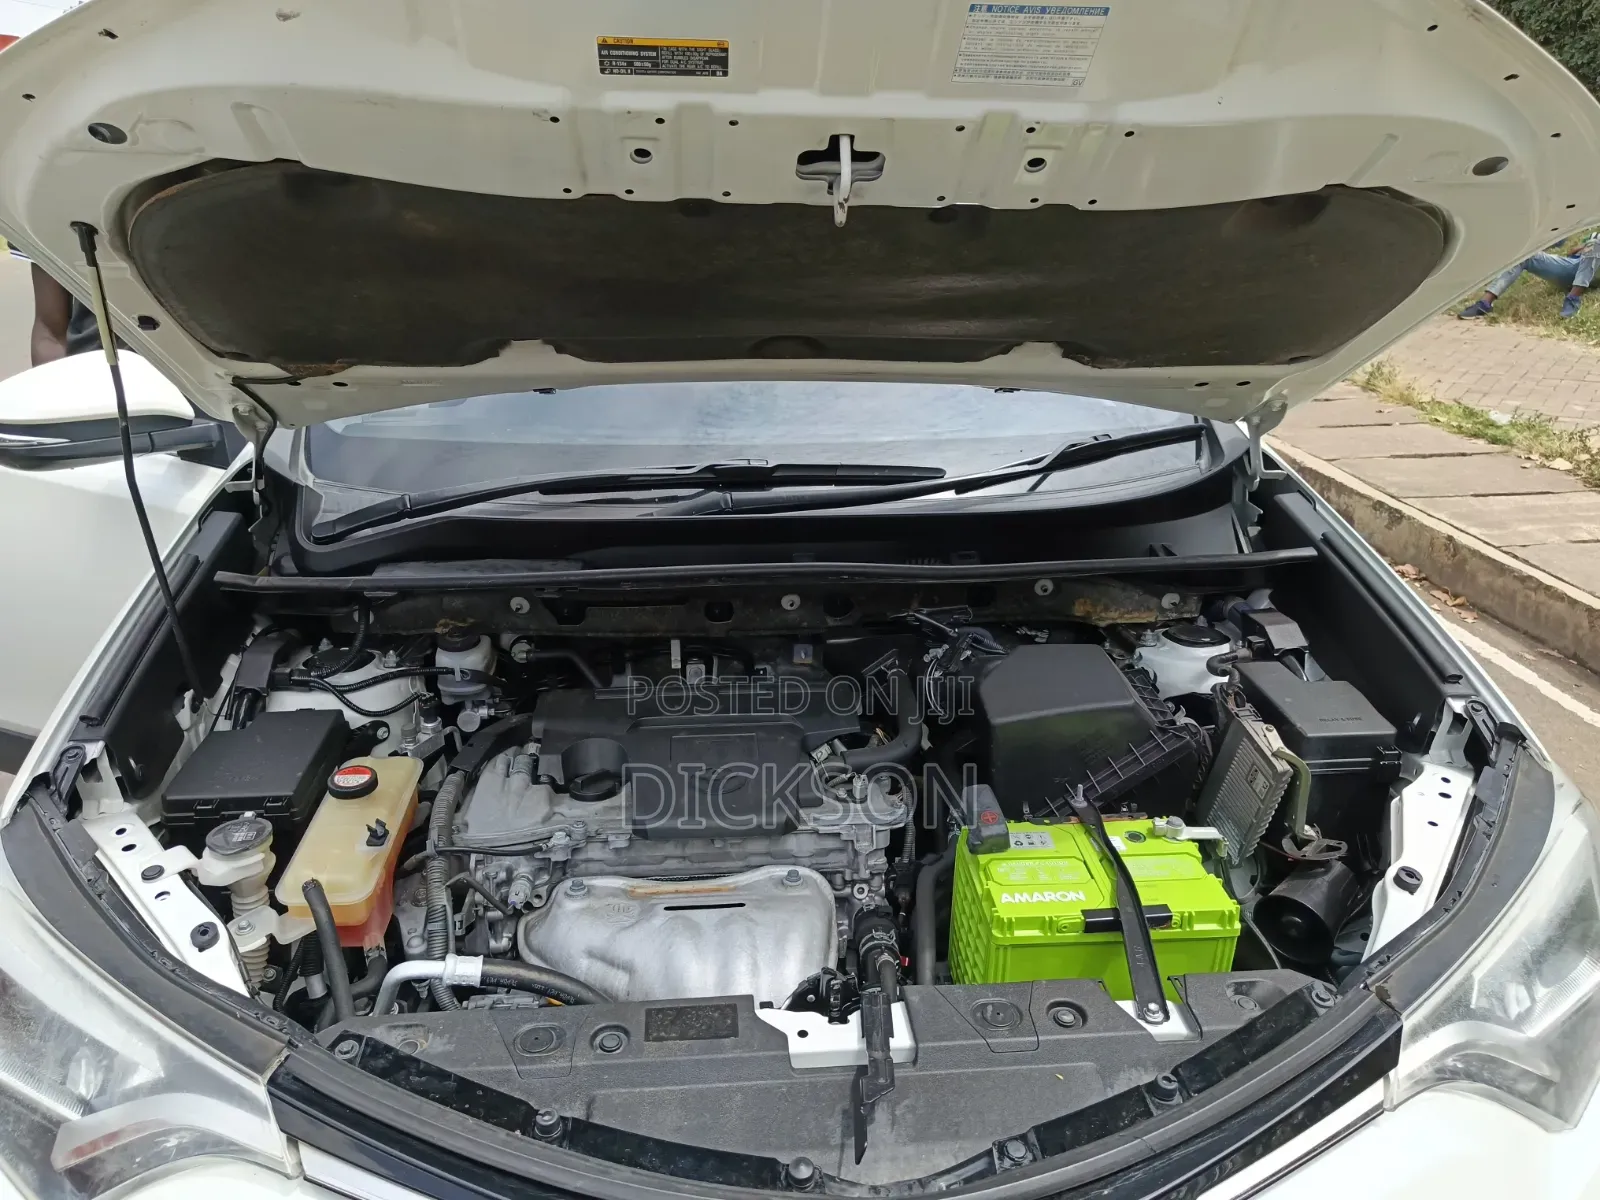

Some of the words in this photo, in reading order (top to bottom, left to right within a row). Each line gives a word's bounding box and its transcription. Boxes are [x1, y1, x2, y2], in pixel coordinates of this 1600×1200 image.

[992, 6, 1020, 14] NOTICE
[1023, 6, 1041, 14] AVIS
[1045, 6, 1105, 16] УВЕДОМЛЕНИЕ
[1000, 890, 1086, 904] AMARON
